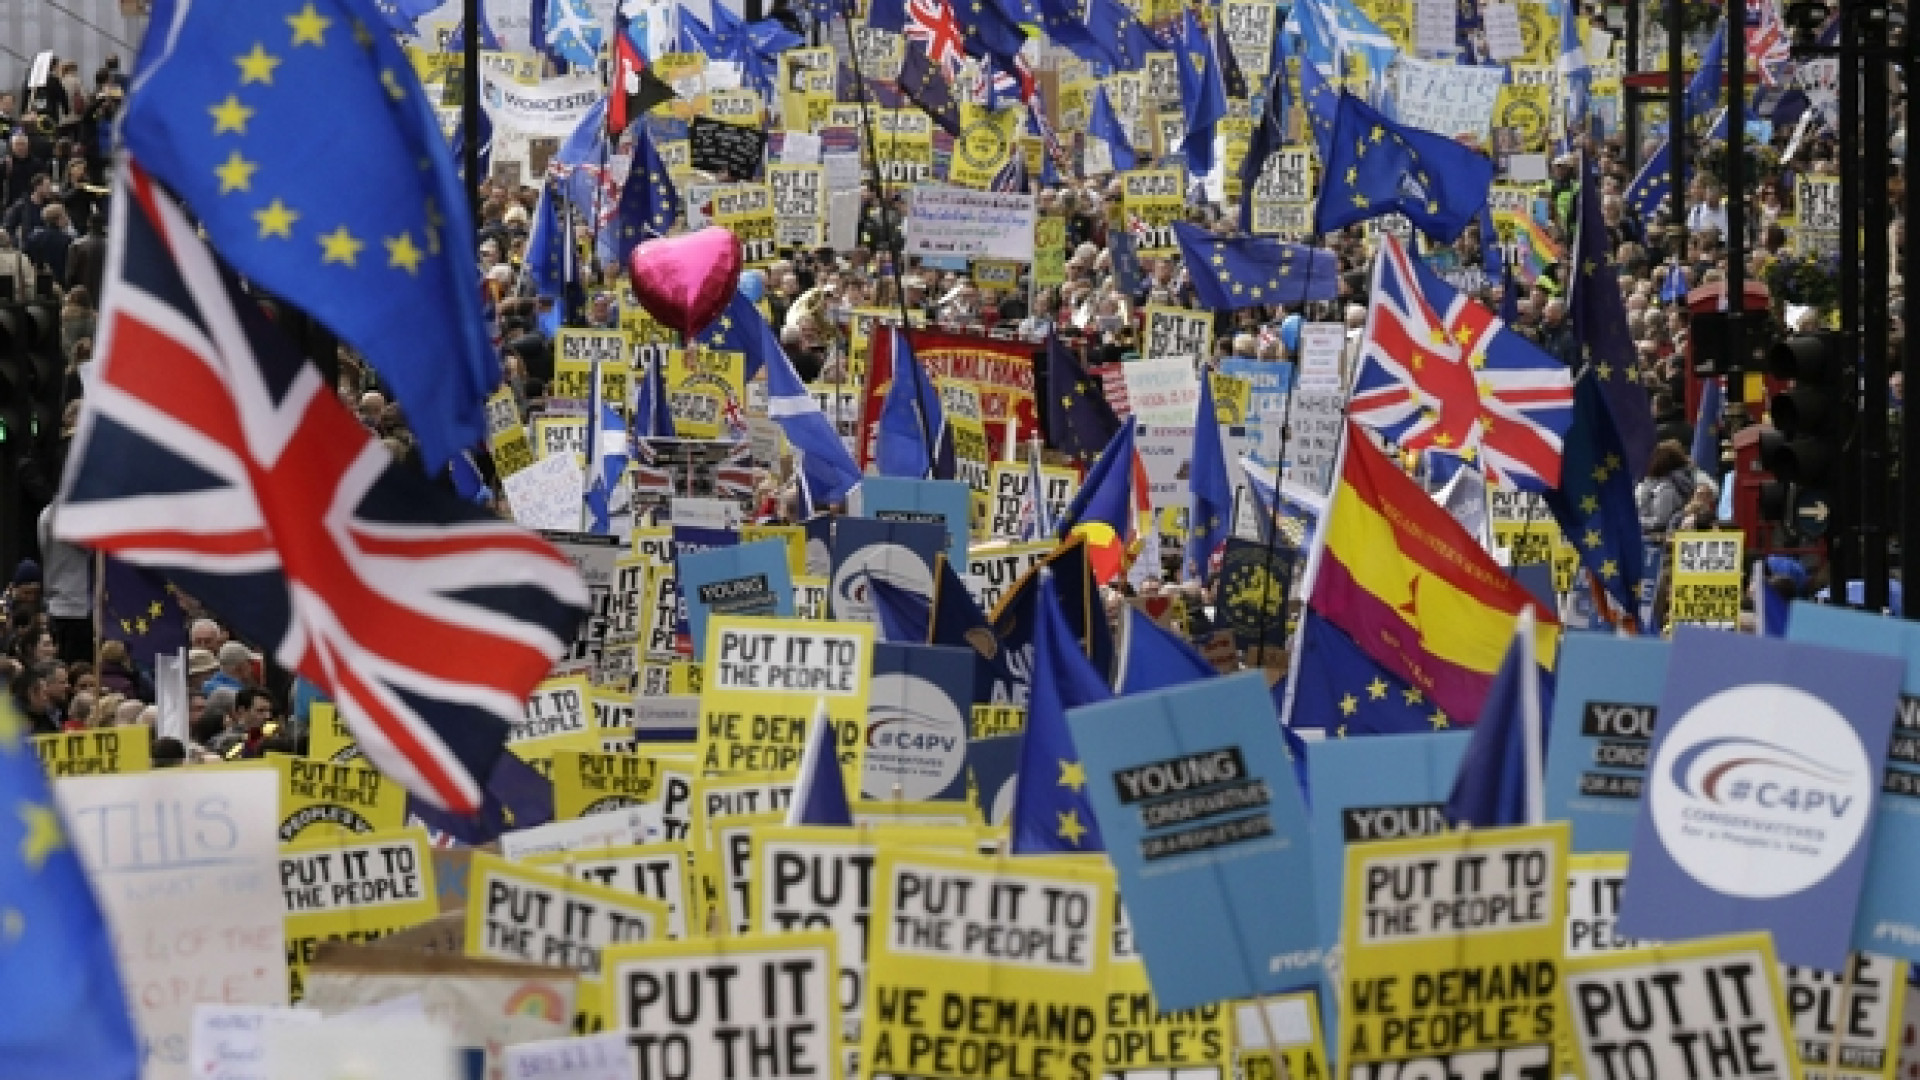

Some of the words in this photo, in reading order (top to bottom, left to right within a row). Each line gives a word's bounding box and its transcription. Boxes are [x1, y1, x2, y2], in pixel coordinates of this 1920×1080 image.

[505, 90, 597, 115] WORCESTER
[879, 161, 930, 180] VOTE
[1151, 312, 1184, 334] PUT
[544, 427, 573, 441] PUT
[999, 473, 1029, 495] PU
[1049, 479, 1068, 499] IT
[620, 565, 641, 590] IT
[721, 633, 775, 662] PUT
[786, 637, 813, 664] IT
[824, 639, 856, 667] TO
[719, 662, 761, 687] THE
[767, 665, 854, 691] PEOPLE
[551, 689, 580, 713] TO
[708, 711, 743, 740] WE
[880, 732, 956, 752] #C4PV
[67, 735, 85, 759] IT
[93, 733, 118, 756] TO
[579, 754, 616, 776] PUT
[704, 742, 719, 768] A
[290, 762, 327, 784] PUT
[333, 765, 350, 787] IT
[356, 768, 380, 791] TO
[290, 780, 318, 799] THE
[321, 783, 378, 808] PEOPLE
[1121, 755, 1238, 798] YOUNG
[770, 787, 795, 810] IT
[1728, 778, 1853, 819] #C4PV
[76, 796, 238, 871] THIS
[280, 854, 330, 886] PUT
[343, 850, 370, 880] IT
[381, 846, 414, 874] TO
[634, 861, 671, 899] IT
[771, 852, 875, 909] PUT
[1367, 861, 1438, 905] PUT
[1455, 856, 1488, 895] IT
[1503, 849, 1546, 889] TO
[284, 886, 323, 910] THE
[333, 876, 418, 904] PEOPLE
[488, 878, 553, 929] PUT
[564, 899, 595, 939] IT
[608, 911, 646, 943] TO
[896, 871, 974, 917] PUT
[988, 883, 1028, 923] IT
[1041, 887, 1089, 930] TO
[1593, 877, 1627, 917] IT
[1365, 904, 1420, 938] THE
[1431, 890, 1544, 931] PEOPLE
[486, 920, 533, 958] THE
[894, 915, 954, 953] THE
[962, 921, 1087, 966] PEOPLE
[628, 964, 739, 1029] PUT
[763, 959, 815, 1021] IT
[1351, 974, 1398, 1015] WE
[1412, 960, 1555, 1011] DEMAND
[1574, 972, 1682, 1040] PUT
[1704, 963, 1754, 1022] IT
[876, 984, 928, 1028] WE
[942, 992, 1097, 1046] DEMAND
[1350, 1022, 1371, 1054] A
[1381, 1002, 1555, 1052] PEOPLE'S
[626, 1033, 691, 1080] TO
[714, 1022, 816, 1078] THE
[873, 1030, 894, 1067] A
[908, 1033, 1094, 1080] PEOPLE'S
[1590, 1038, 1656, 1080] TO
[1670, 1022, 1776, 1077] THE
